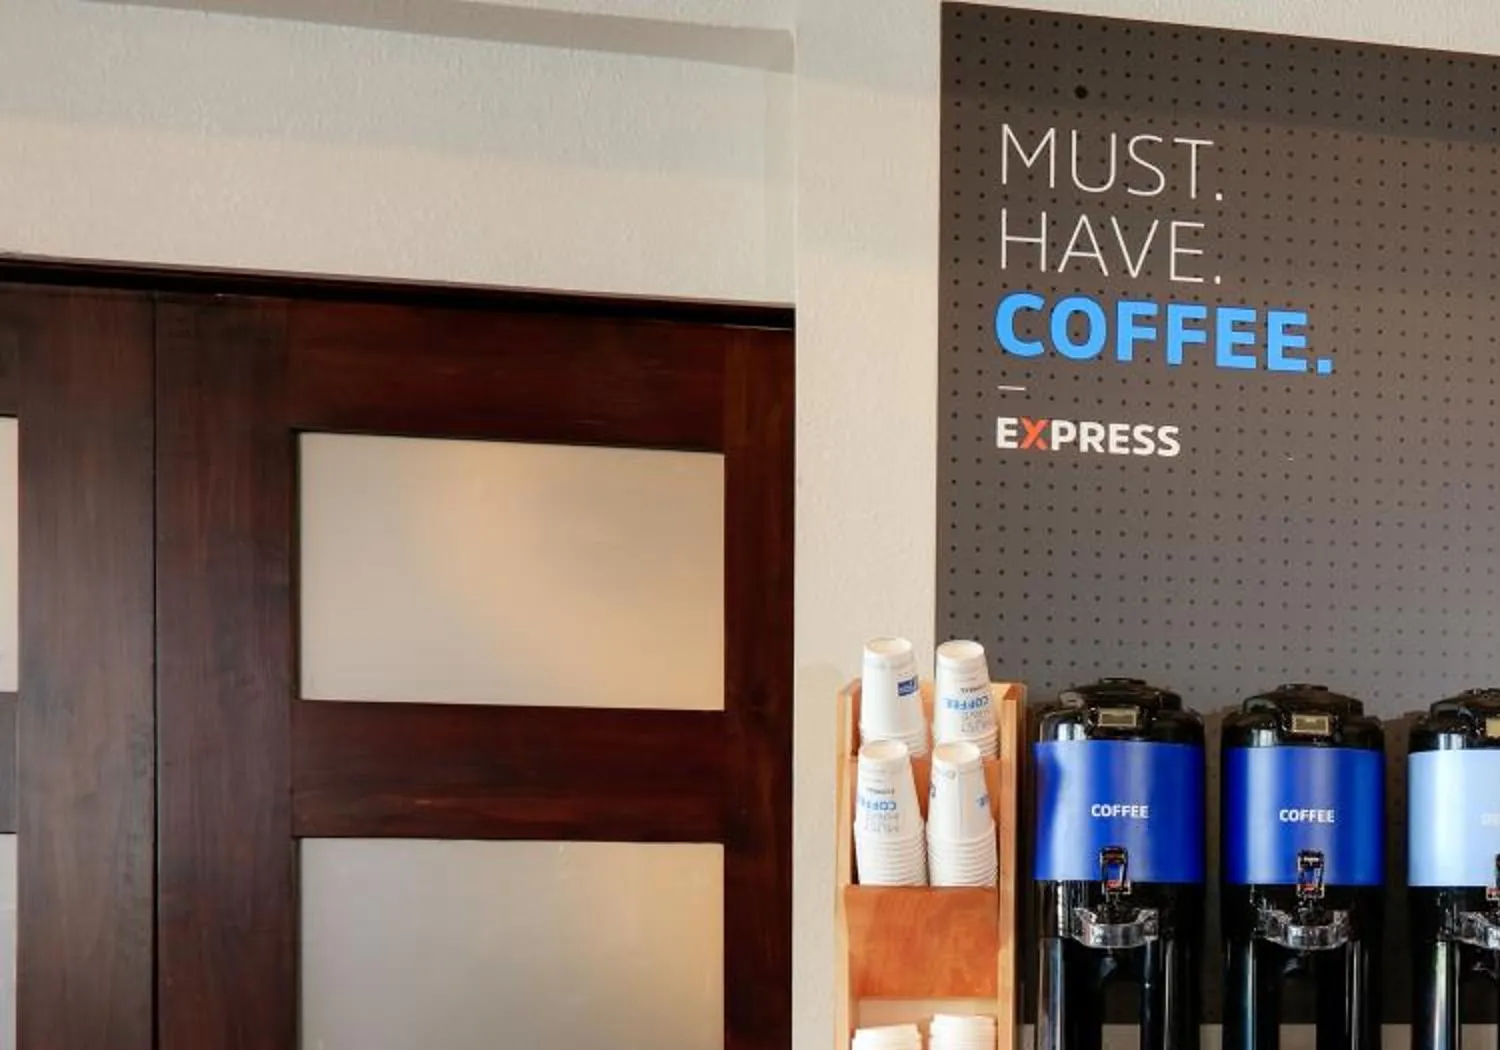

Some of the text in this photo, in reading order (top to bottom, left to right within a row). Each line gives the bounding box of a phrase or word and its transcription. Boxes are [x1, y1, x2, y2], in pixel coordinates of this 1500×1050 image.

[1001, 123, 1223, 201] MUST.
[1001, 207, 1221, 285] HAVE.
[995, 291, 1333, 376] COFFEE.
[997, 415, 1181, 457] EXPRESS
[1091, 803, 1149, 819] COFFEE
[1279, 809, 1335, 824] COFFEE
